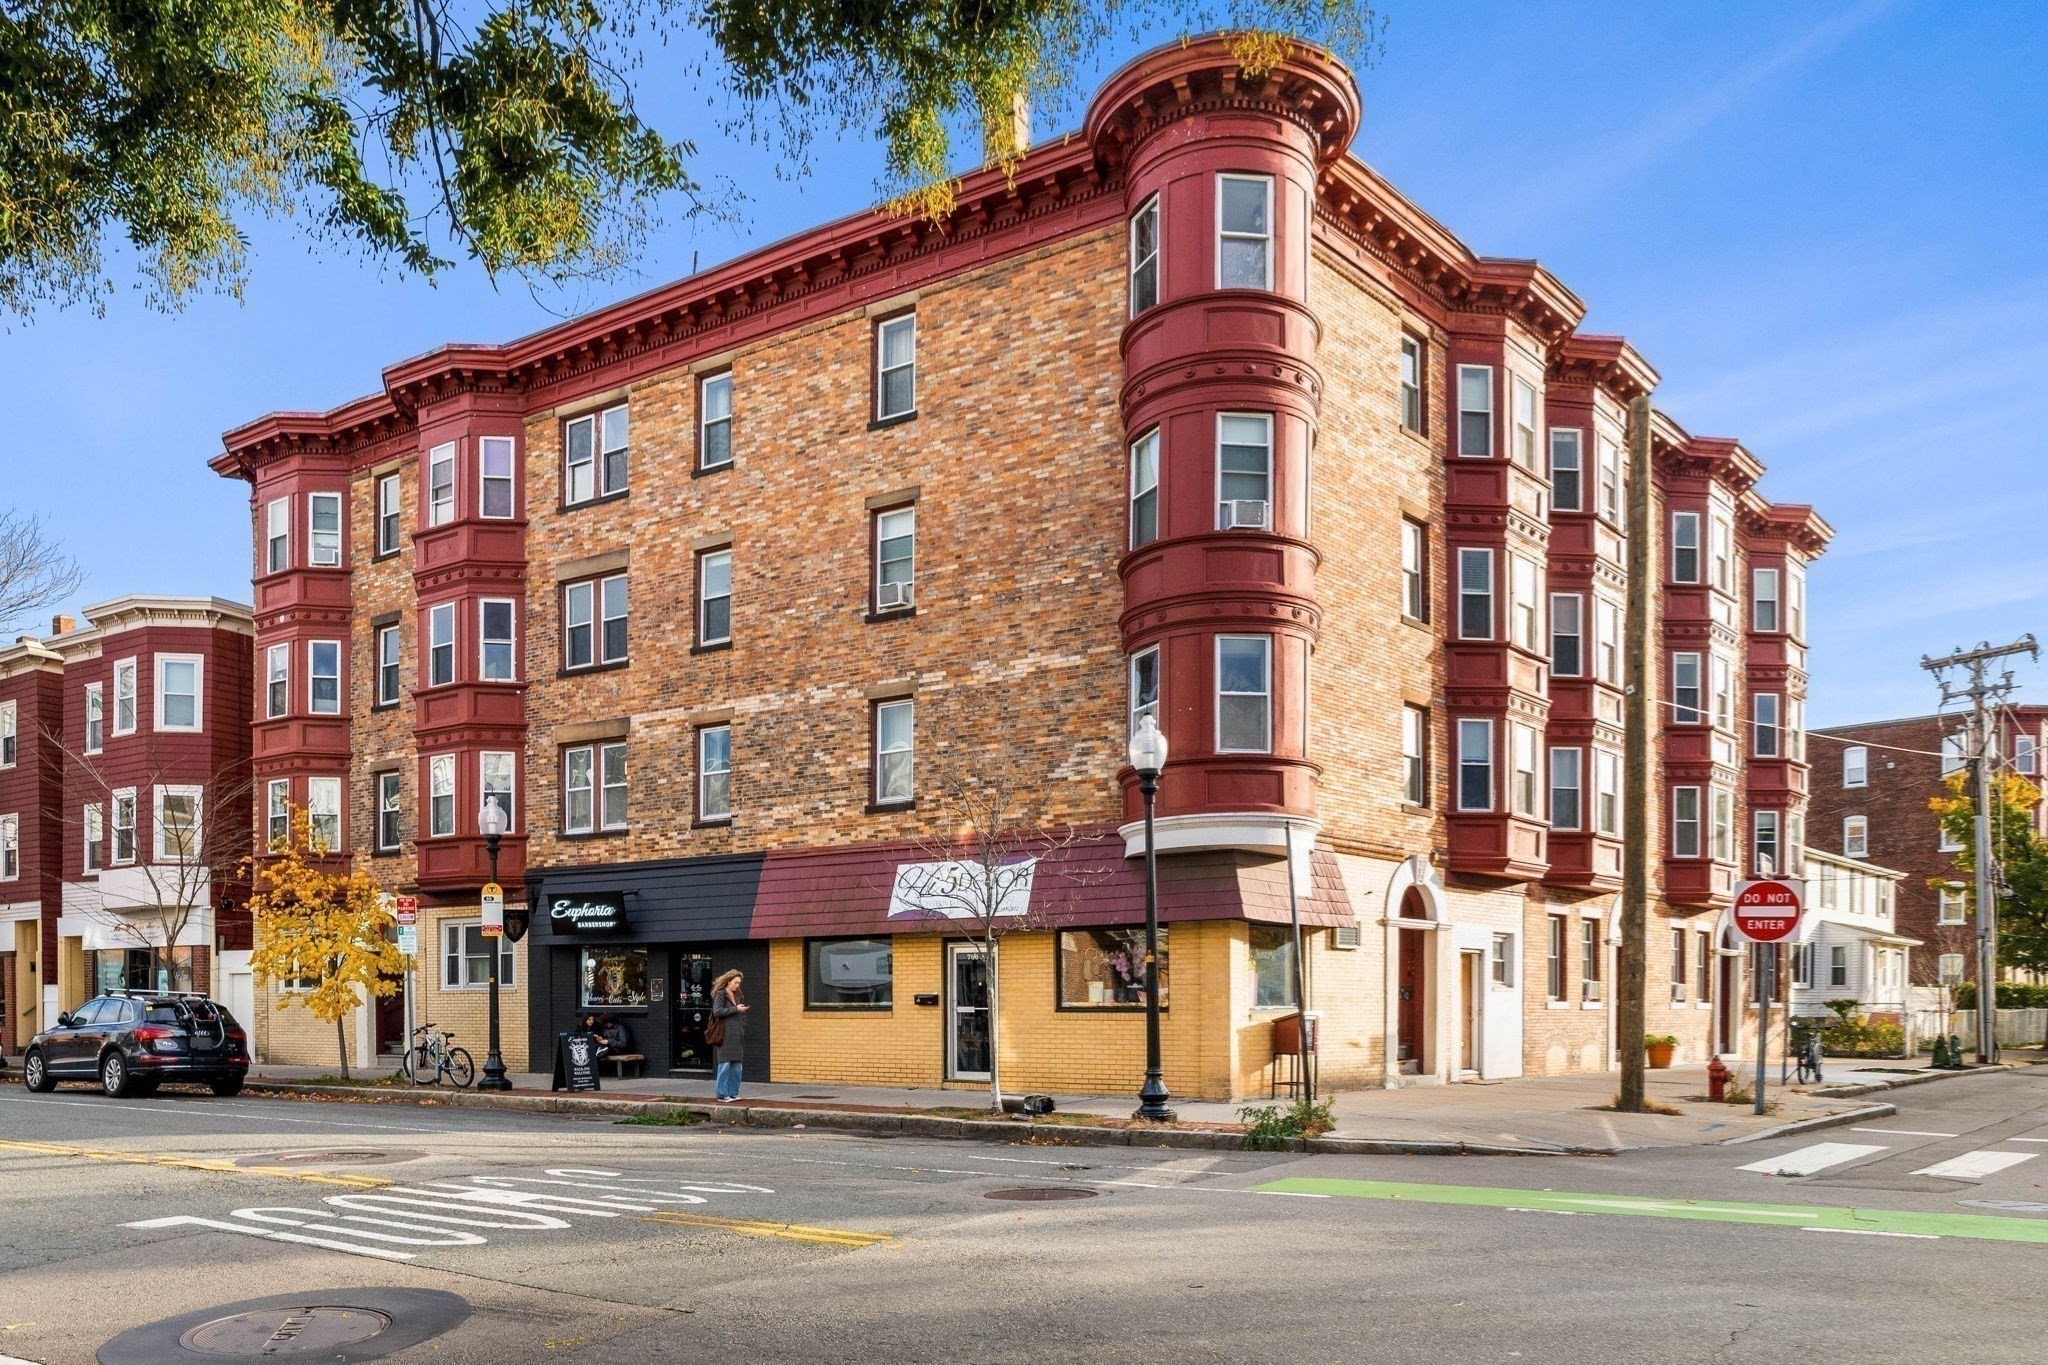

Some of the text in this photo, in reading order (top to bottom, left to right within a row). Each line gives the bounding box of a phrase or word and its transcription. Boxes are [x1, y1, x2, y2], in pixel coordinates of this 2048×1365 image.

[1743, 893, 1791, 904] DO NOT
[550, 899, 617, 922] Euphoria
[1746, 919, 1785, 930] ENTER
[118, 1166, 776, 1261] SCHOOL
